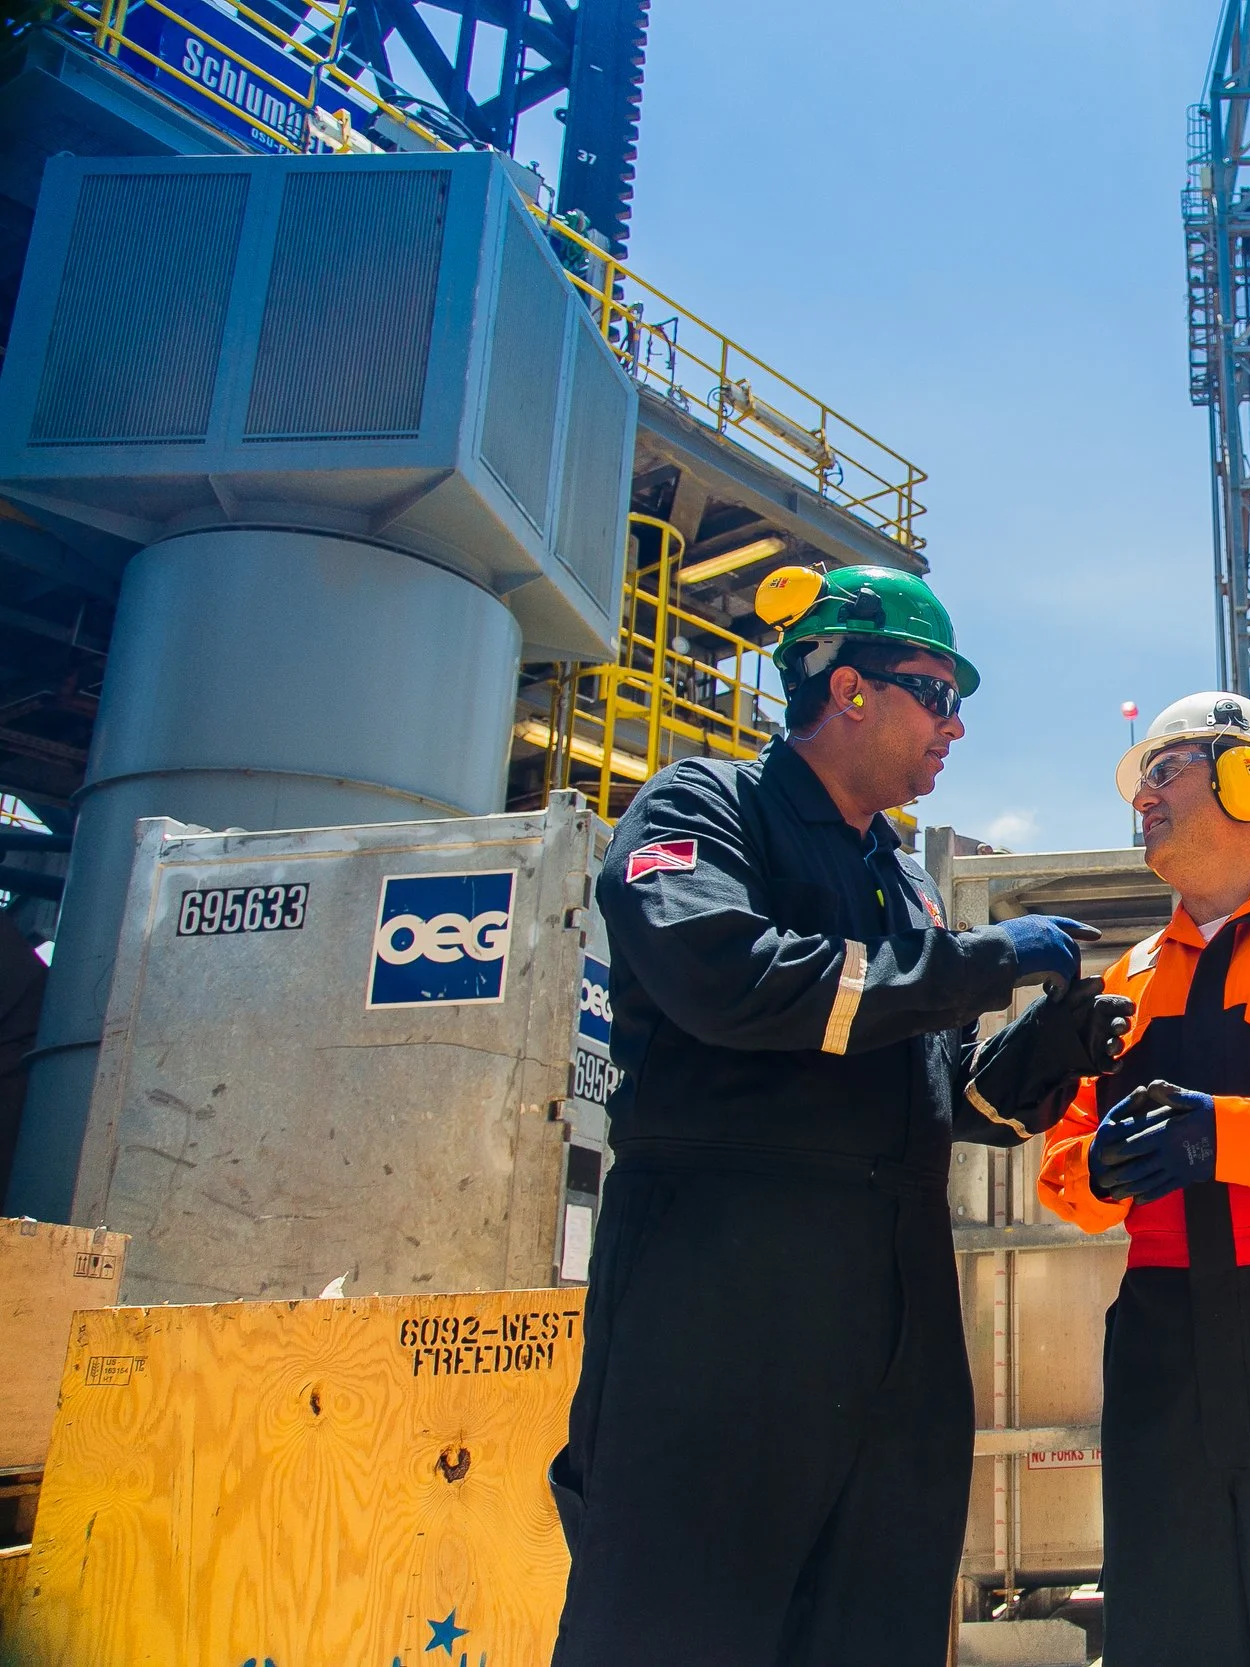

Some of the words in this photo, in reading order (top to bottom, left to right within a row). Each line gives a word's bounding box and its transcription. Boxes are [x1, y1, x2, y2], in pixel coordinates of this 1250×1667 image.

[577, 149, 597, 165] 37
[179, 885, 307, 935] 695633
[400, 1311, 581, 1347] 6092-WEST
[413, 1342, 555, 1377] FREEDOM
